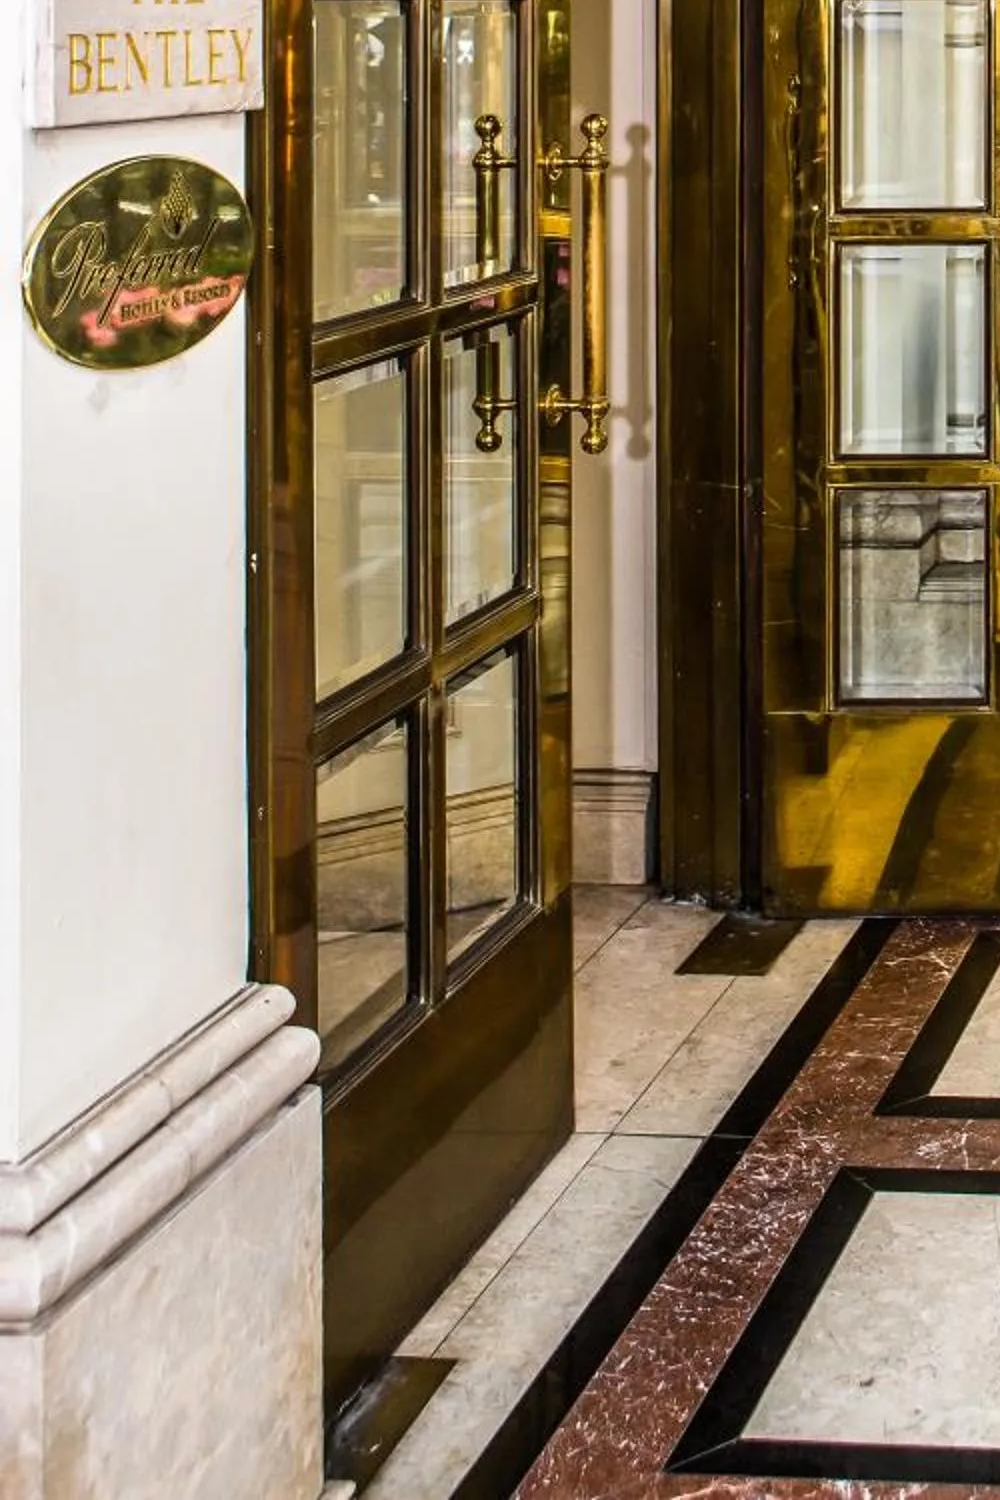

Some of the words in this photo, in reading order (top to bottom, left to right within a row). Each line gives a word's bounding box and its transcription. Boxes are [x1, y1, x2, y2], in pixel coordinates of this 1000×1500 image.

[67, 27, 253, 97] BENTLEY
[52, 215, 221, 328] Preferred
[170, 293, 181, 309] &
